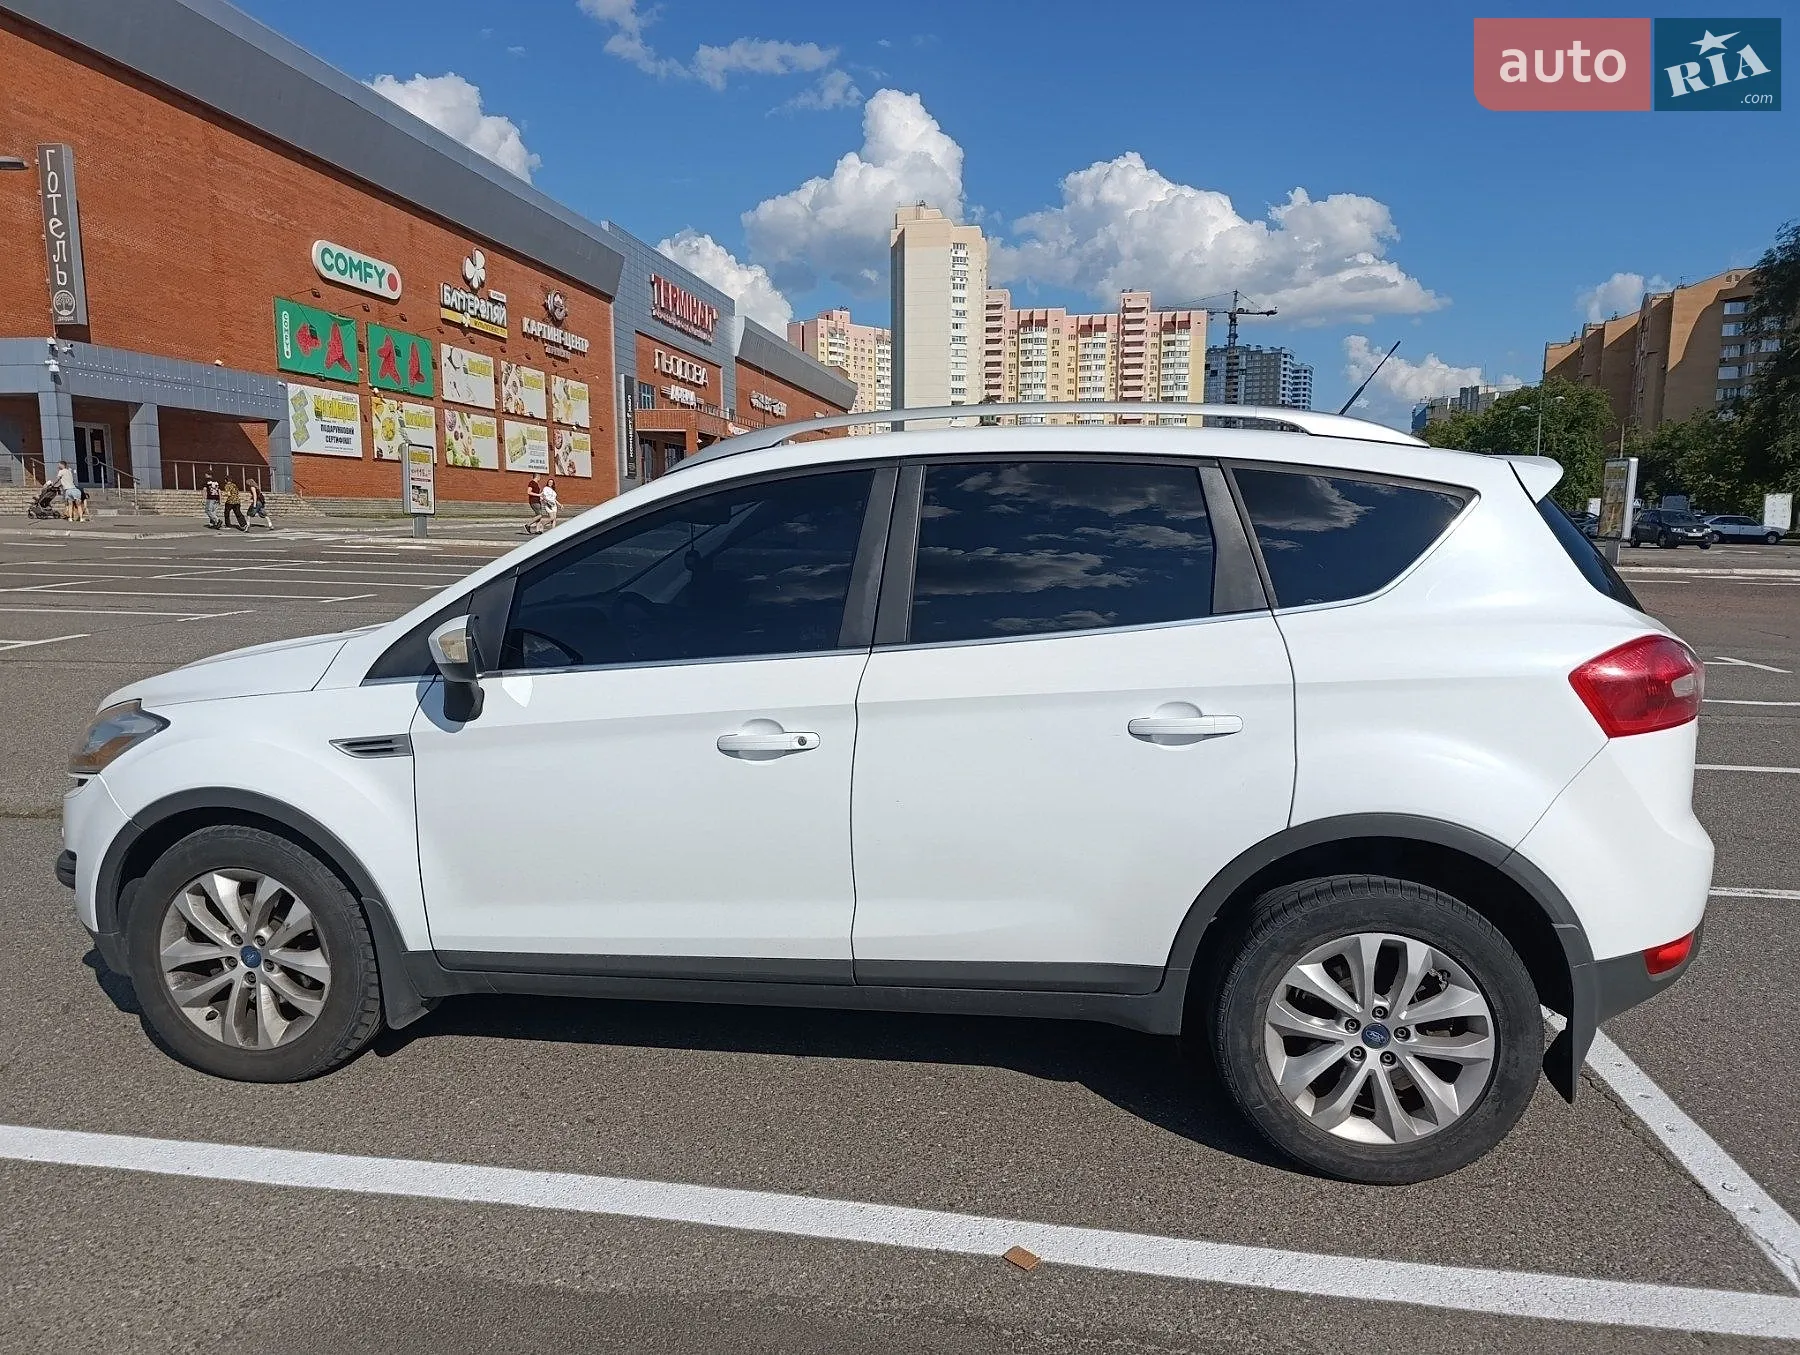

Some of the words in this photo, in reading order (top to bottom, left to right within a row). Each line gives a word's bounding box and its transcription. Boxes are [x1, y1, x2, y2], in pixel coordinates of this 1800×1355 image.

[320, 247, 386, 289] COMFY
[522, 317, 589, 353] КАРТИНГ-ЦЕНТР
[654, 349, 709, 387] ЛЬОДОВА
